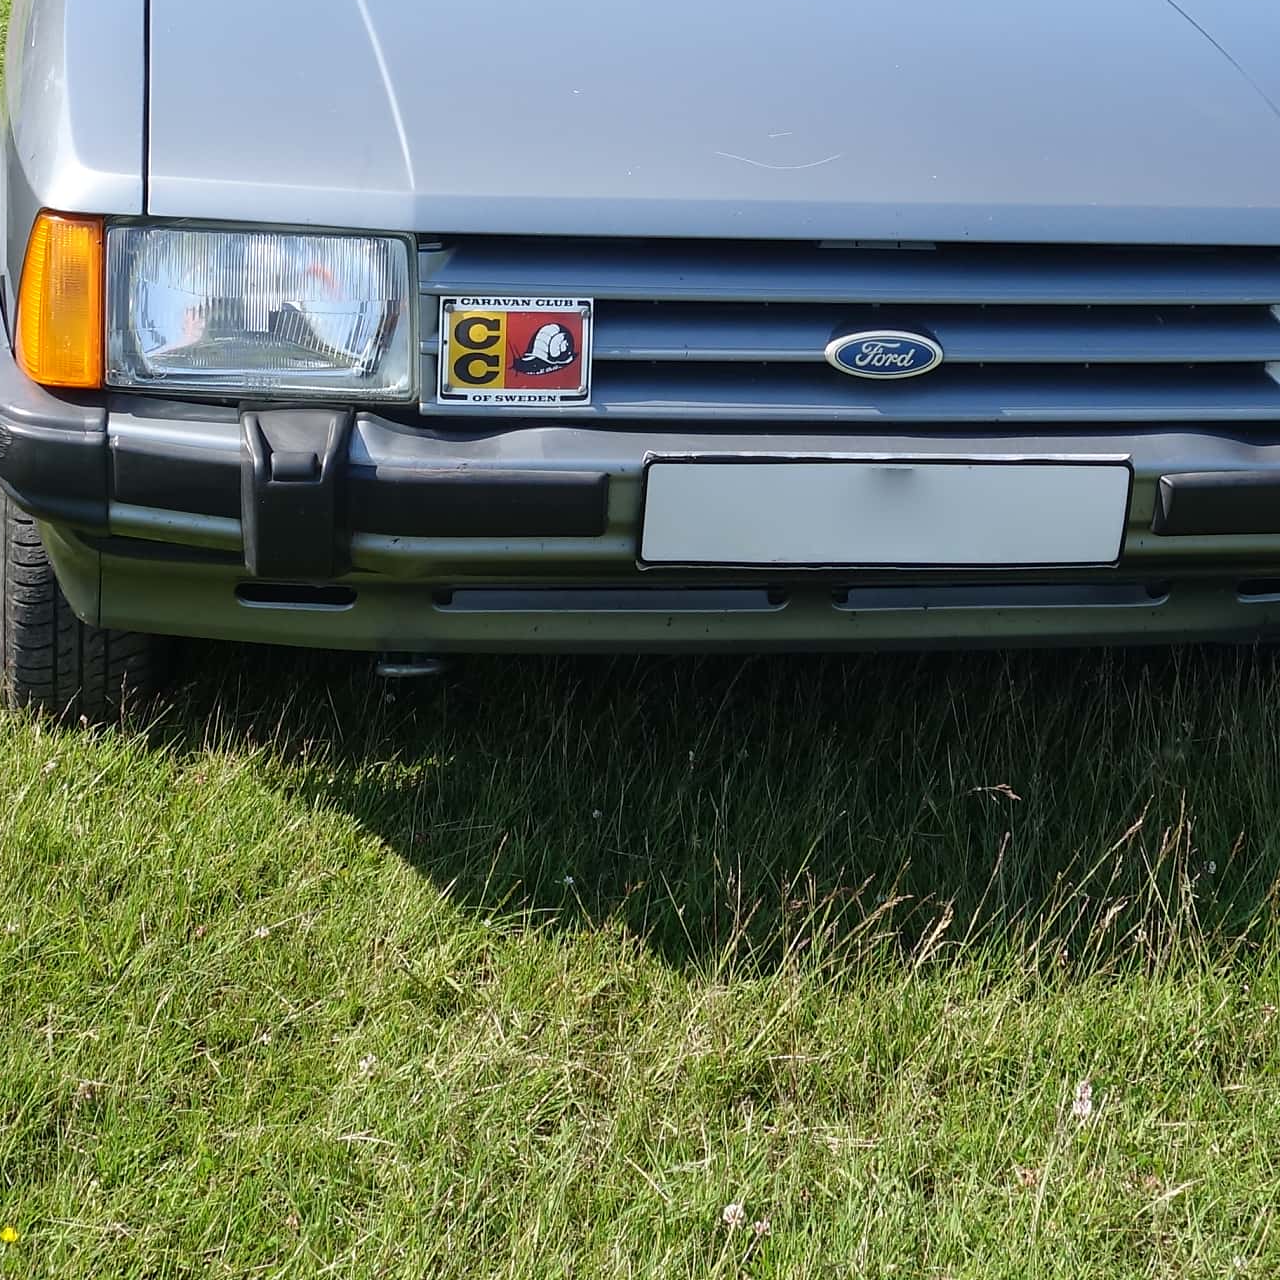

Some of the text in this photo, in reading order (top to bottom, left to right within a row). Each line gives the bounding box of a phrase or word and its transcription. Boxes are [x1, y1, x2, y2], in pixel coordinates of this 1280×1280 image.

[460, 297, 574, 307] CARAVAN CLUB
[855, 341, 916, 367] Ford
[472, 394, 557, 403] OF SWEDEN
